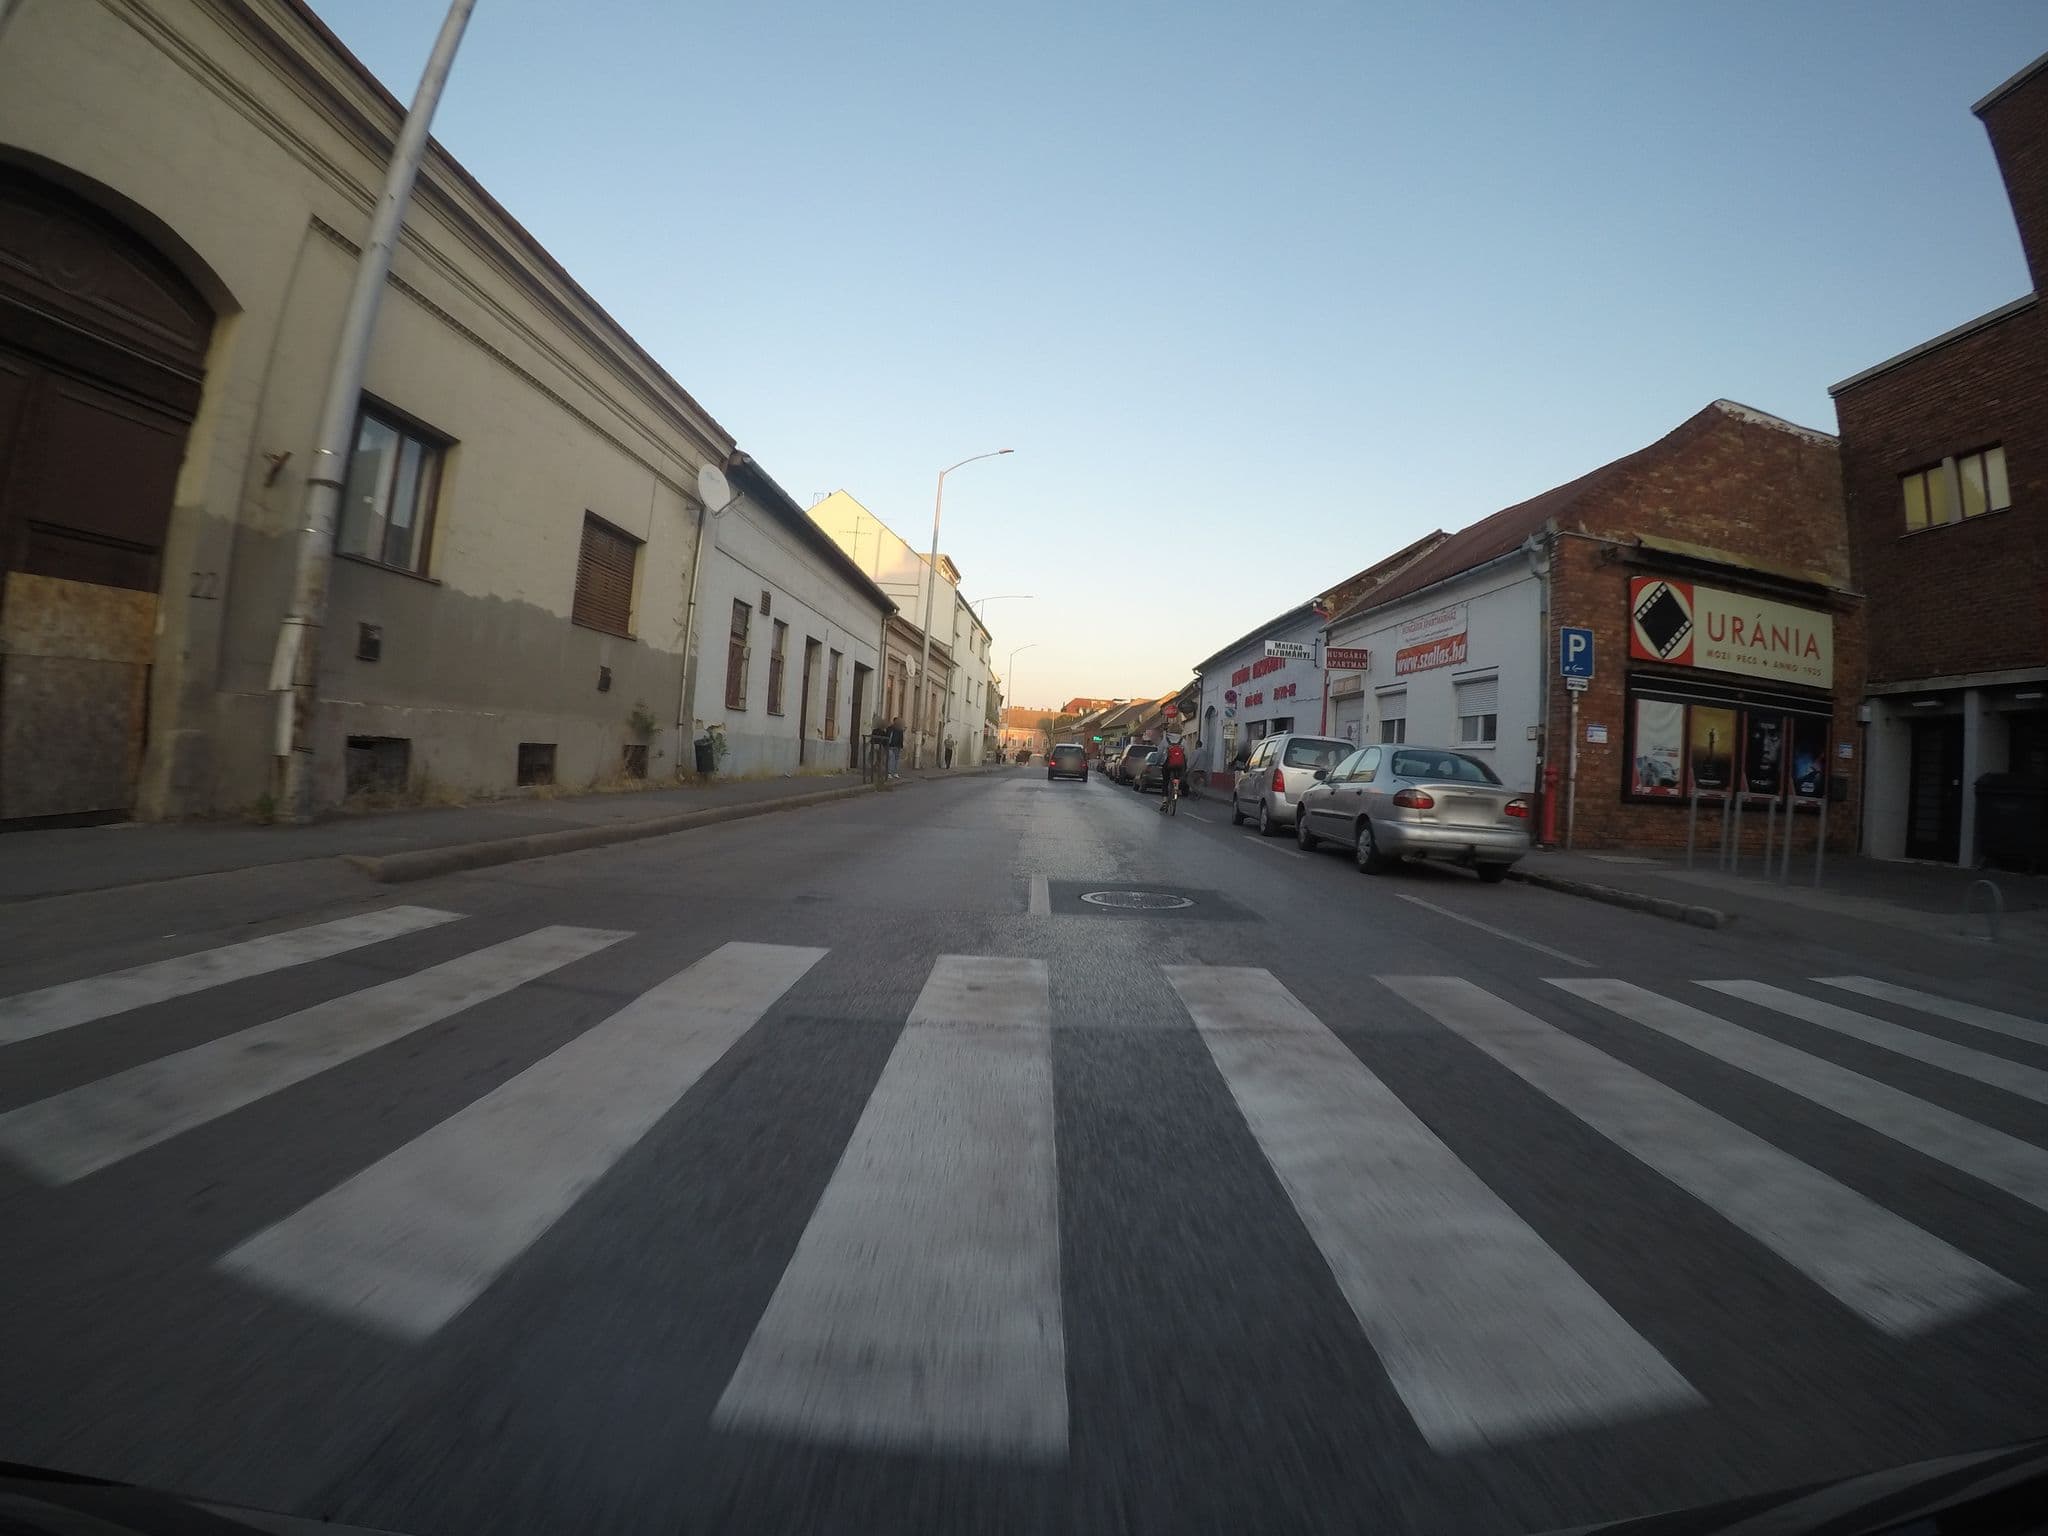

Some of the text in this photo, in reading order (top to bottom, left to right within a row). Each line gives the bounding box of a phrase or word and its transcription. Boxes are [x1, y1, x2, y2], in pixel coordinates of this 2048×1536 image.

[1568, 633, 1587, 662] P
[1707, 611, 1821, 660] URÁNIA
[1327, 649, 1367, 660] HUNGÁRIA
[1327, 660, 1367, 669] APARTMAN
[1397, 641, 1466, 672] www.szallas.hu
